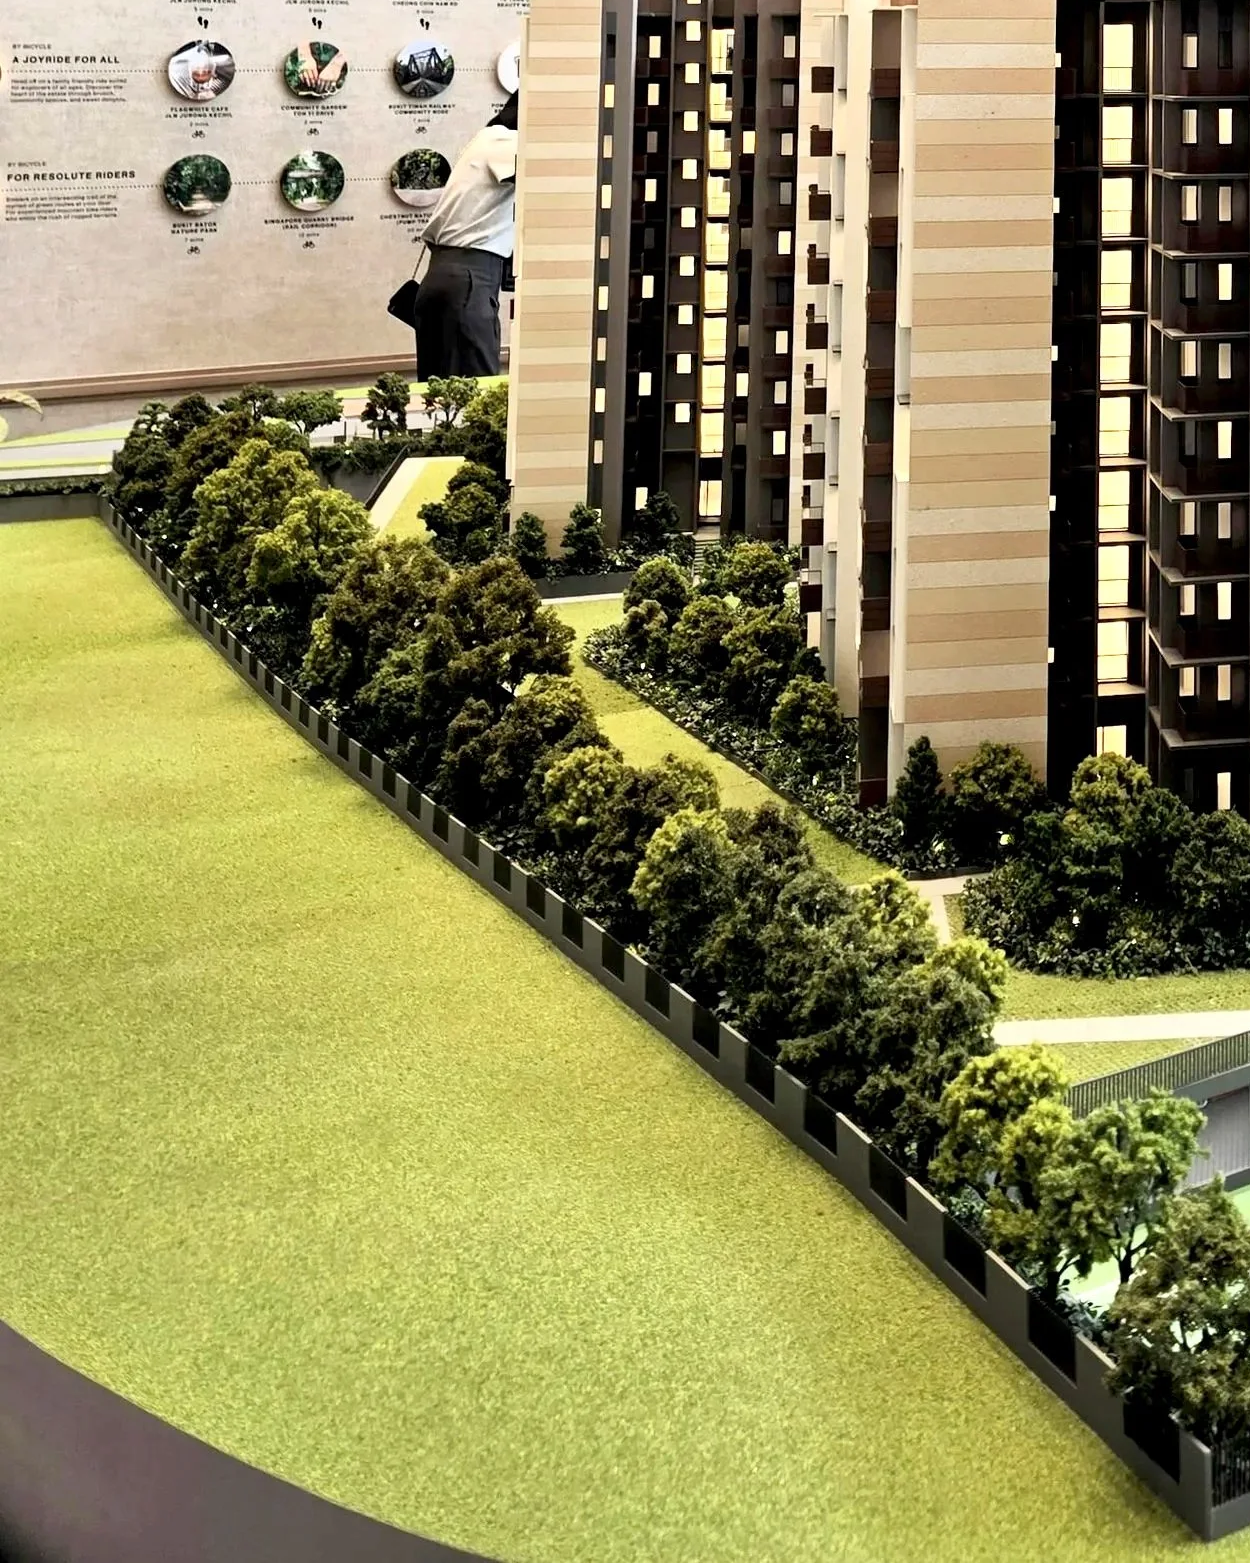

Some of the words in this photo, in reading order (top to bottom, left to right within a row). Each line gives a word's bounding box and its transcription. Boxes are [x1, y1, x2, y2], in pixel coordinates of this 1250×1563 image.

[12, 55, 19, 63] A
[23, 55, 71, 64] JOYRIDE
[74, 55, 97, 63] FOR
[100, 55, 120, 64] ALL
[7, 173, 30, 182] FOR
[33, 172, 92, 181] RESOLUTE
[95, 170, 136, 179] RIDERS
